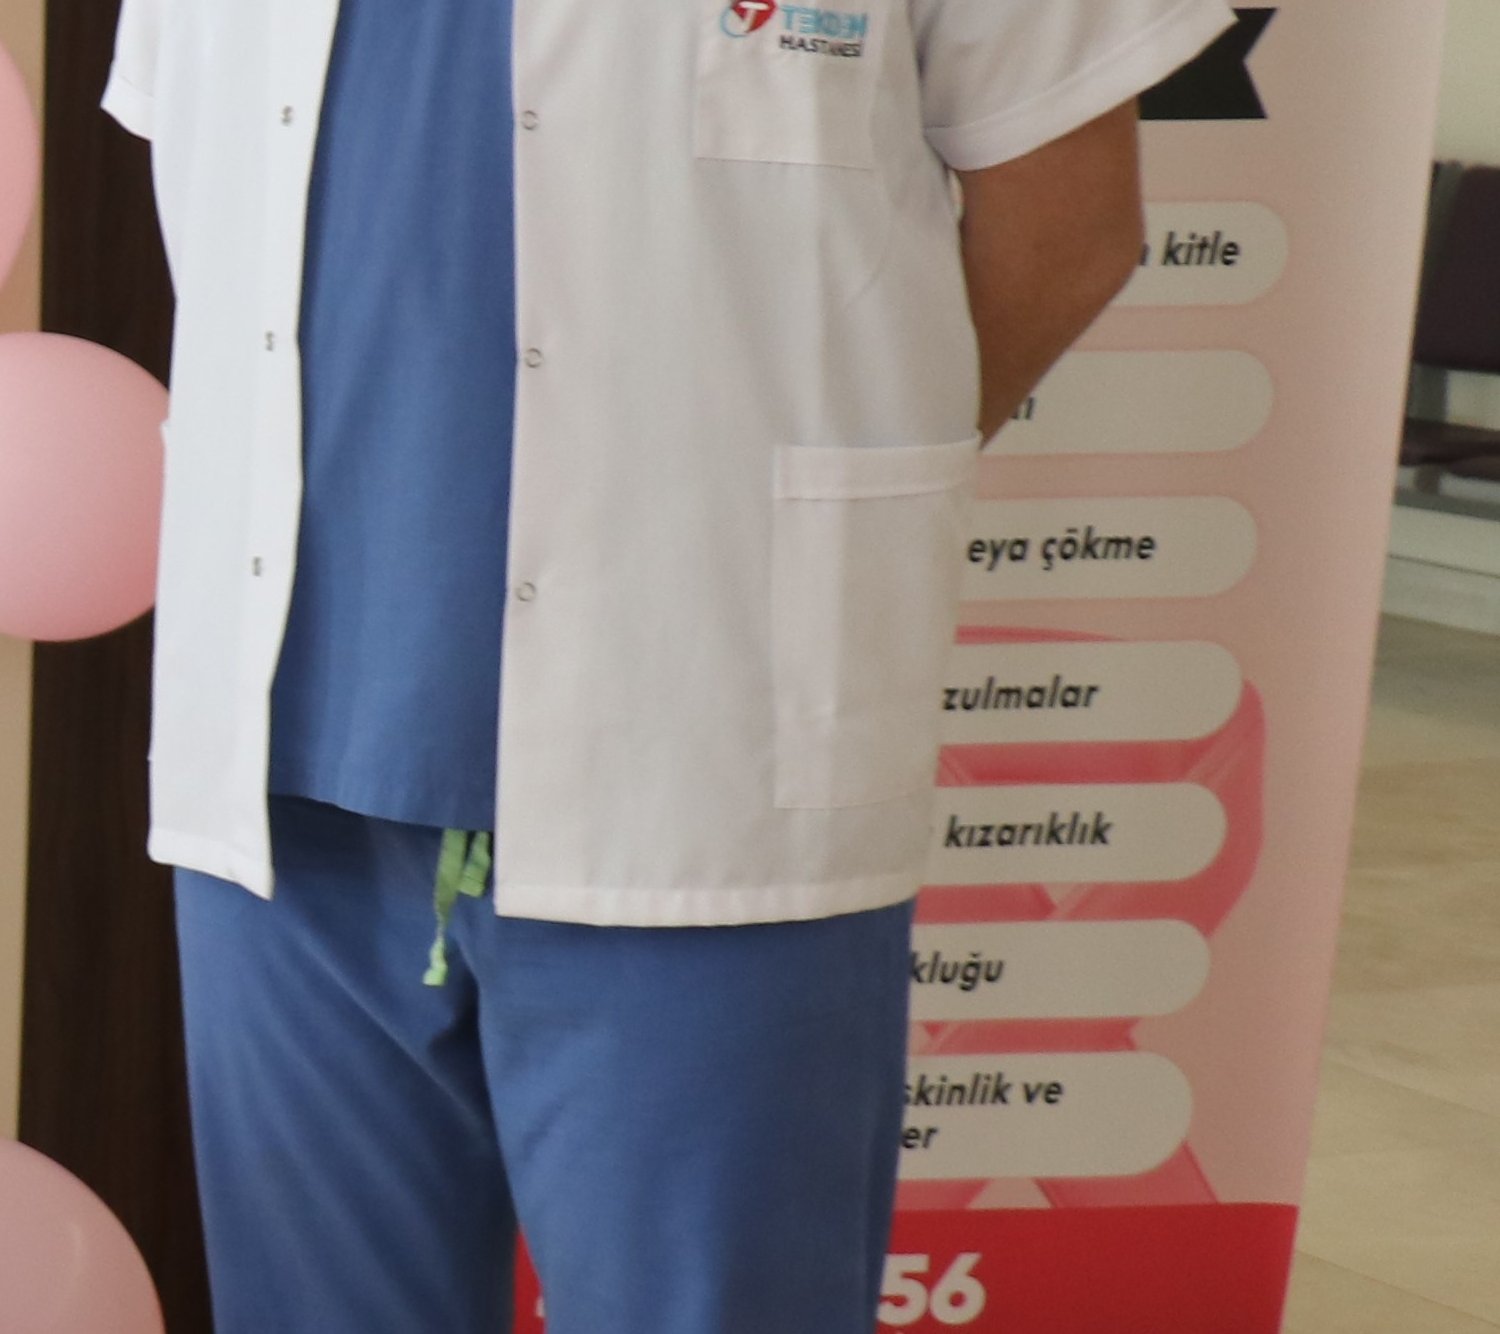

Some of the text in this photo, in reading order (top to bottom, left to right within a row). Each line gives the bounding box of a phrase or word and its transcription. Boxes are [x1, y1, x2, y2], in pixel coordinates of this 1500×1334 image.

[1161, 230, 1241, 267] kitle
[966, 525, 1157, 572] eya çökme
[942, 674, 1100, 712] zulmalar
[944, 811, 1112, 849] kızarıklık
[910, 951, 1006, 992] kluğu
[904, 1072, 1064, 1107] kinlik ve
